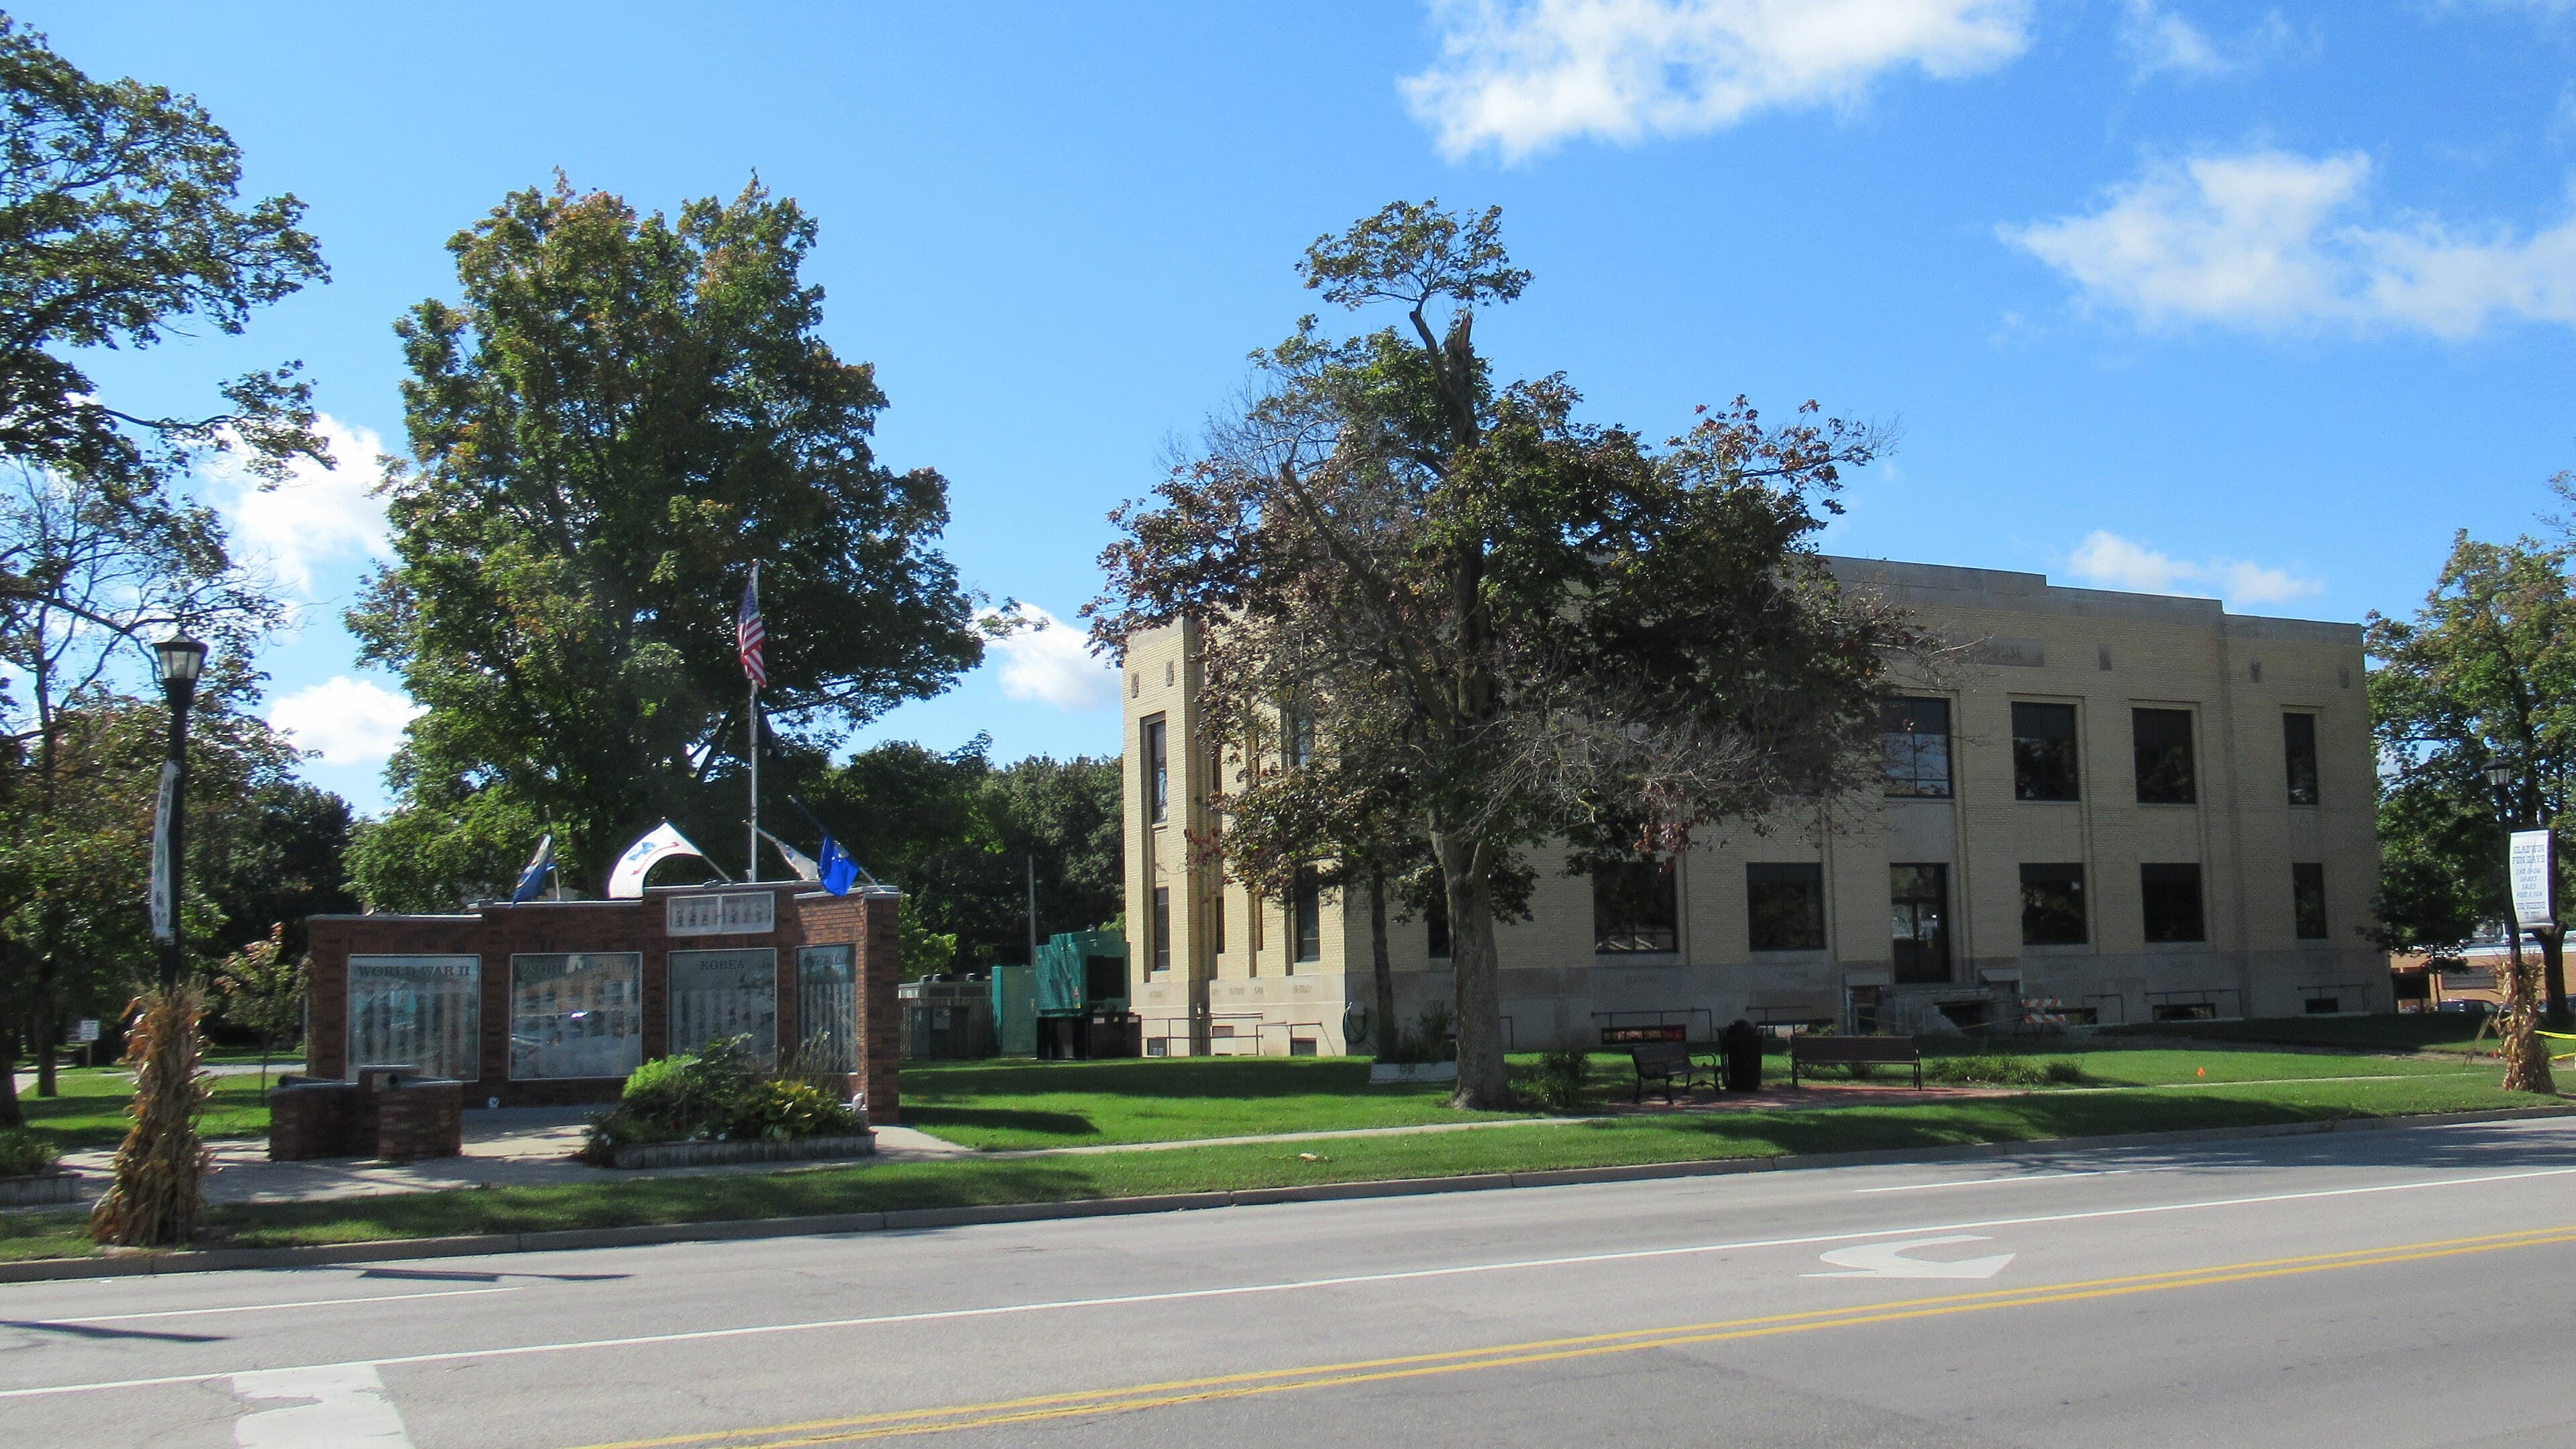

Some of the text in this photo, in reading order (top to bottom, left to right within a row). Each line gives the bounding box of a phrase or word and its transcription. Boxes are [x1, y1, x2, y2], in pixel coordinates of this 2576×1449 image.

[701, 959, 745, 970] KOREA
[358, 965, 470, 977] WORLD WAR II
